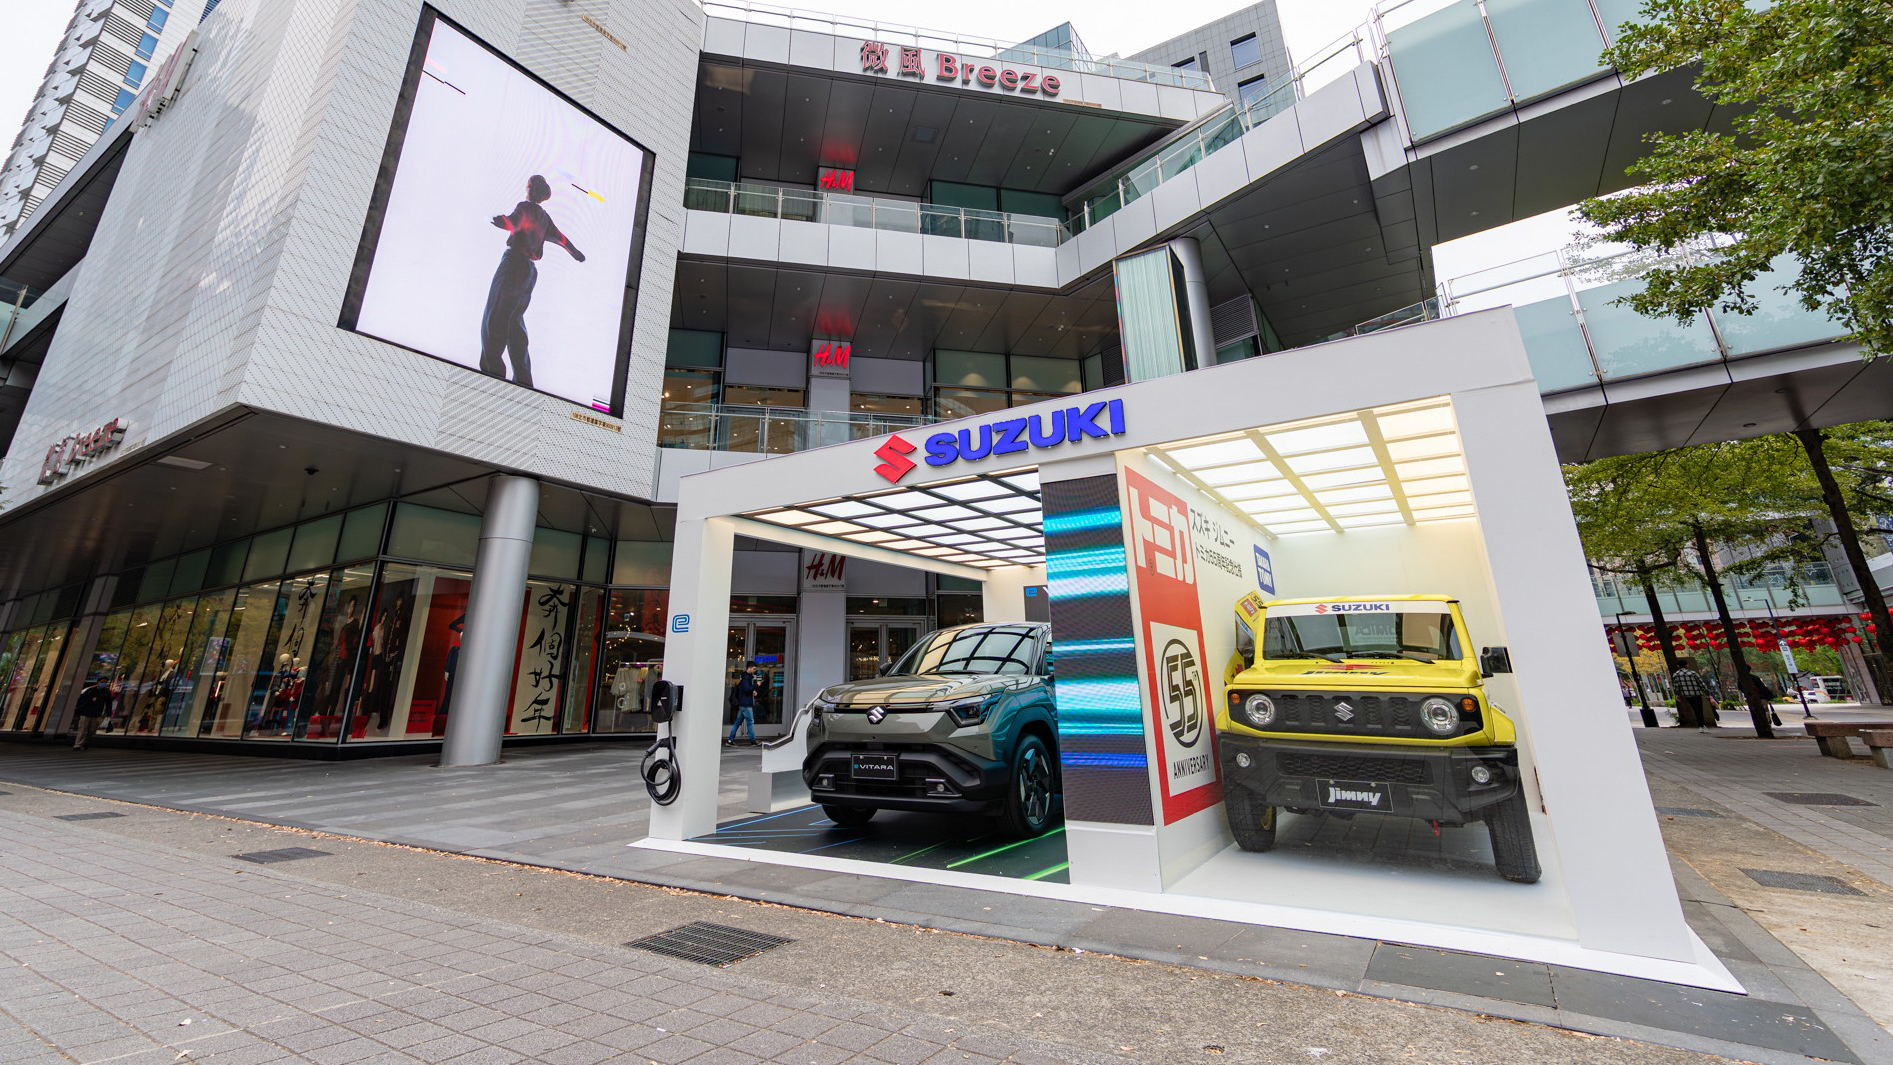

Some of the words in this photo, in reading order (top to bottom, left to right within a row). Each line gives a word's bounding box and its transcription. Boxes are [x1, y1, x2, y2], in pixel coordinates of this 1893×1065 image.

[861, 40, 925, 79] 微風
[937, 53, 1060, 96] Breeze
[820, 169, 854, 191] H&M
[814, 344, 852, 368] H&M
[925, 398, 1125, 467] SUZUKI
[1129, 485, 1195, 585] トミカ
[1190, 508, 1211, 540] スズキ
[1212, 521, 1235, 549] ジムニー
[806, 553, 846, 580] H&M
[1331, 603, 1390, 612] SUZUKI
[520, 584, 569, 733] 奔個好年
[1173, 753, 1211, 780] ANNIVERSARY
[1327, 787, 1382, 806] Jimny
